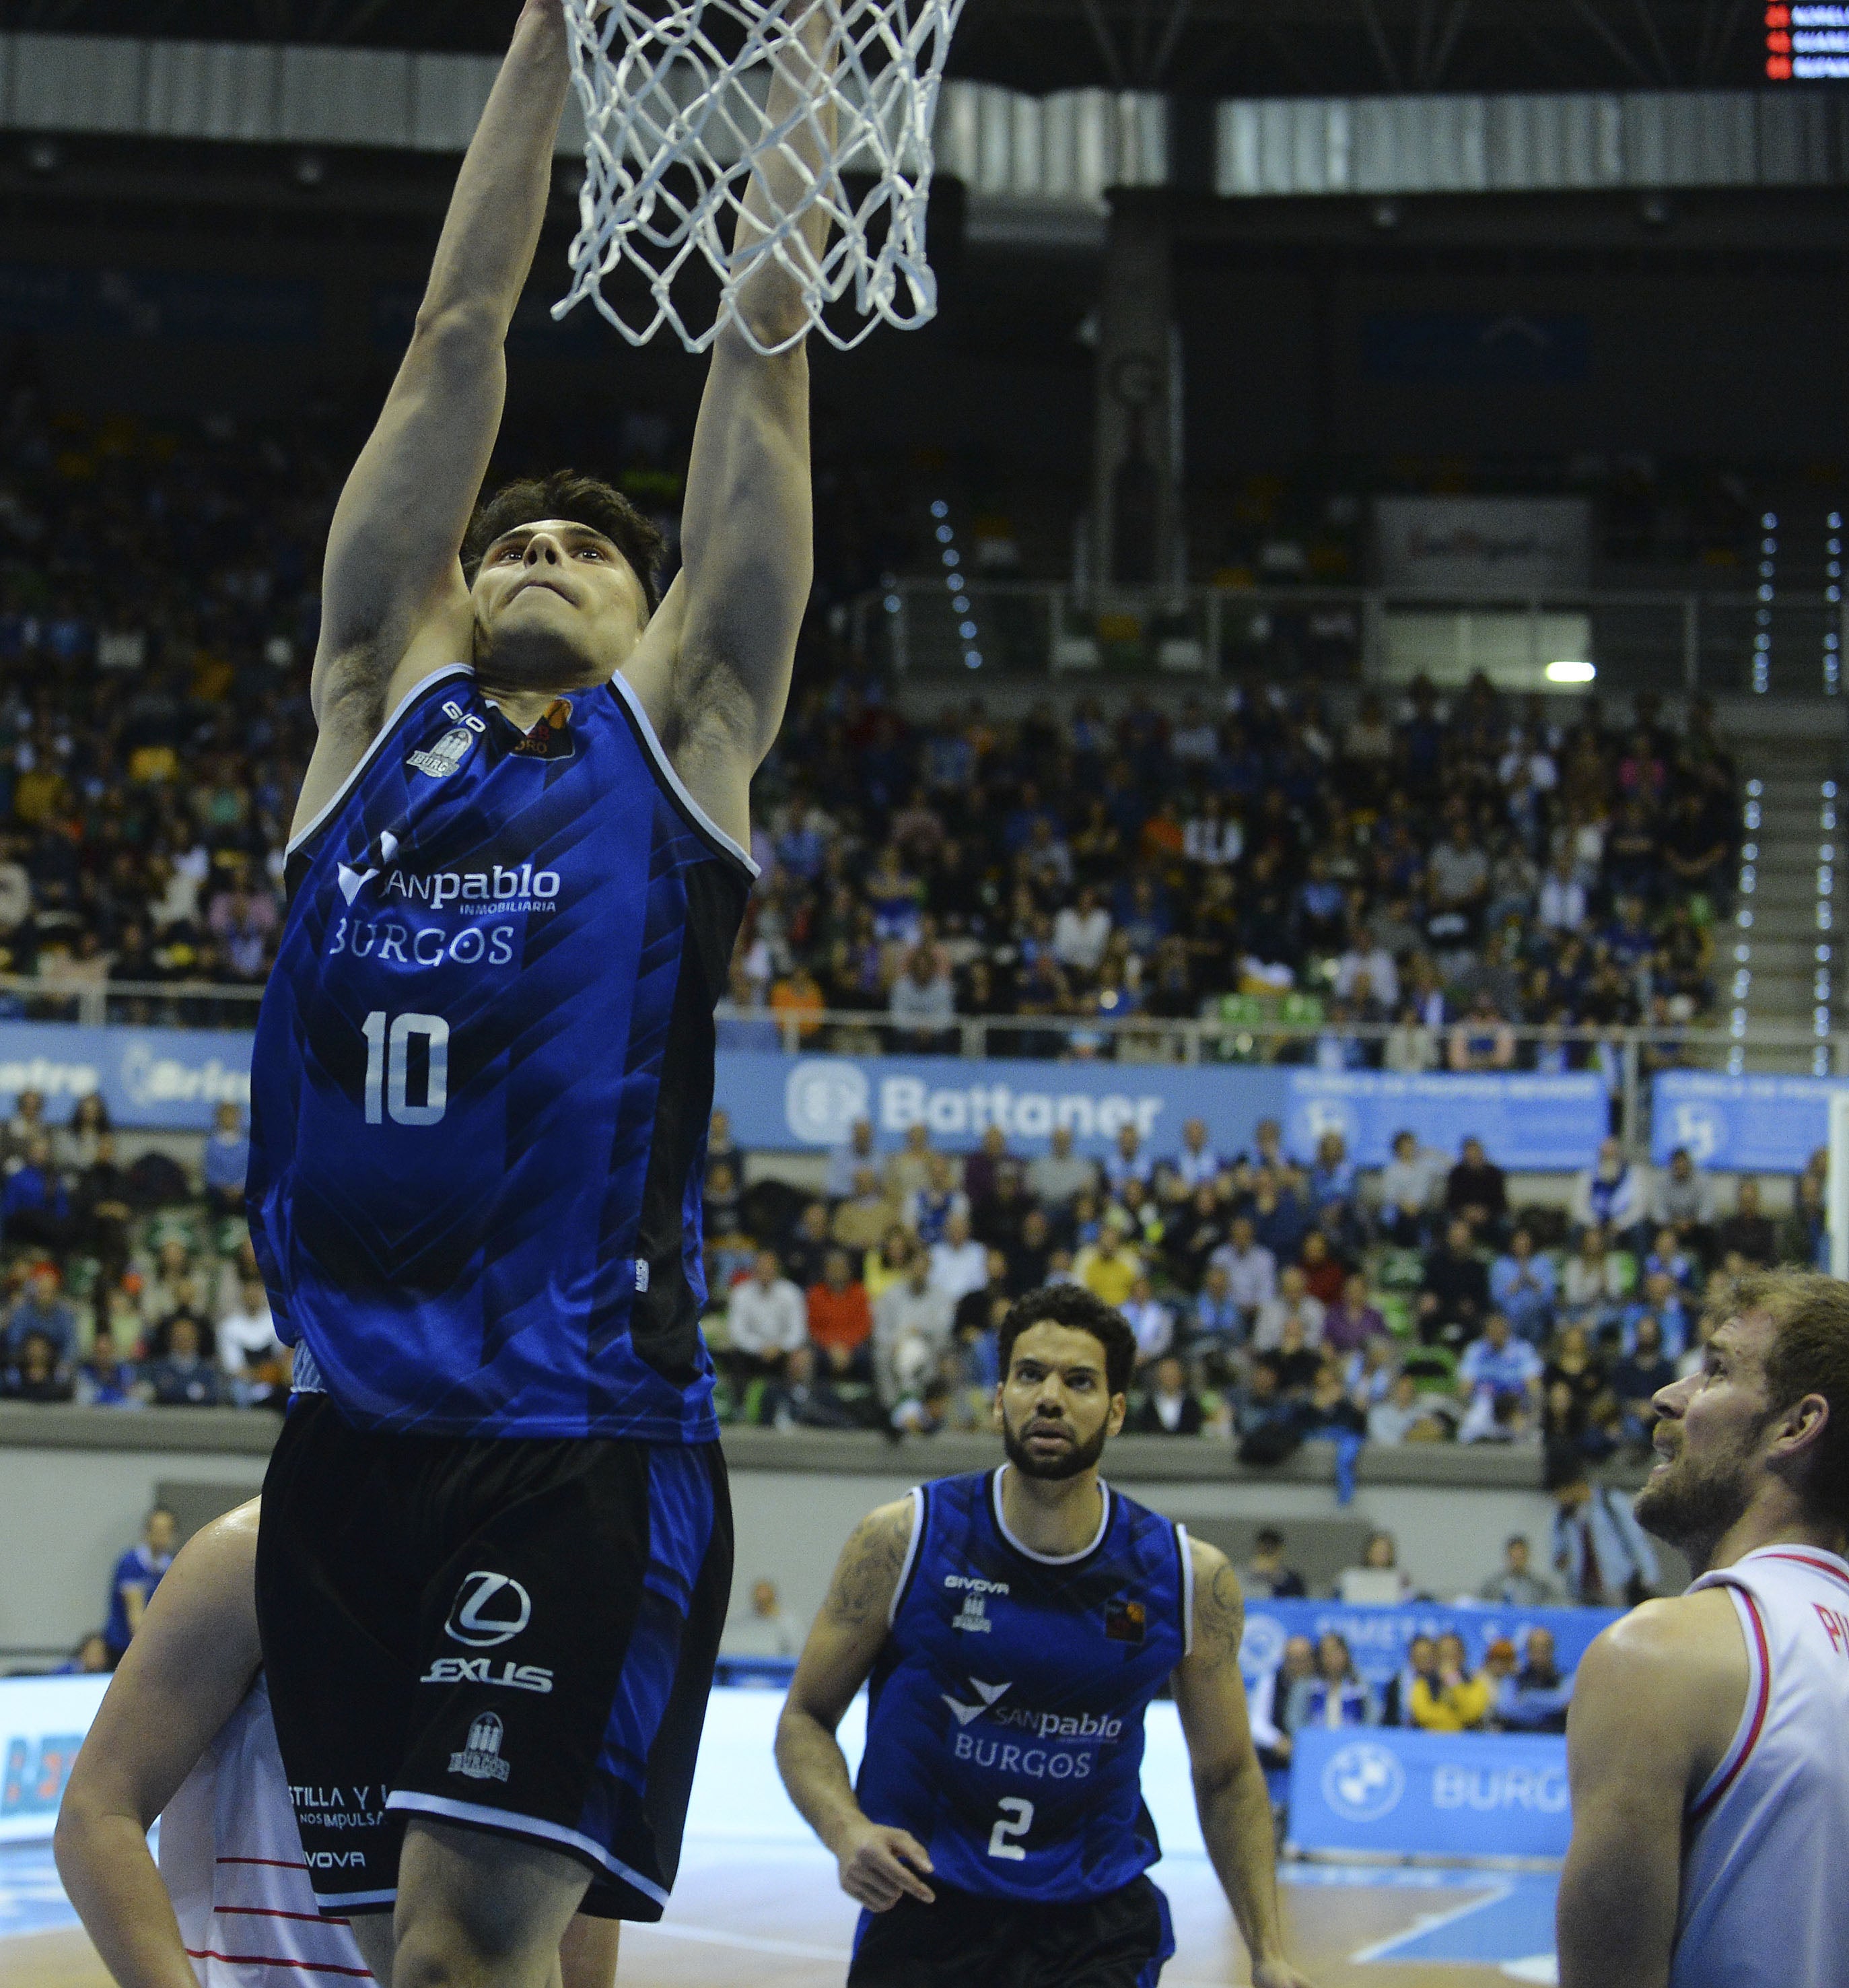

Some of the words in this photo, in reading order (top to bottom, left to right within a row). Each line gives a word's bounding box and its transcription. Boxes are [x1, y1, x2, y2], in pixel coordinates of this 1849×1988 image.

[380, 864, 561, 910] ANpablo
[460, 901, 557, 914] INMOBILIARIA
[361, 1011, 450, 1126] 10
[880, 1078, 1162, 1139] Battaner
[944, 1575, 1010, 1595] GIVOVA
[419, 1658, 554, 1694] EXUS
[954, 1732, 1092, 1779] BURGOS
[353, 1786, 370, 1810] Y
[987, 1796, 1035, 1861] 2
